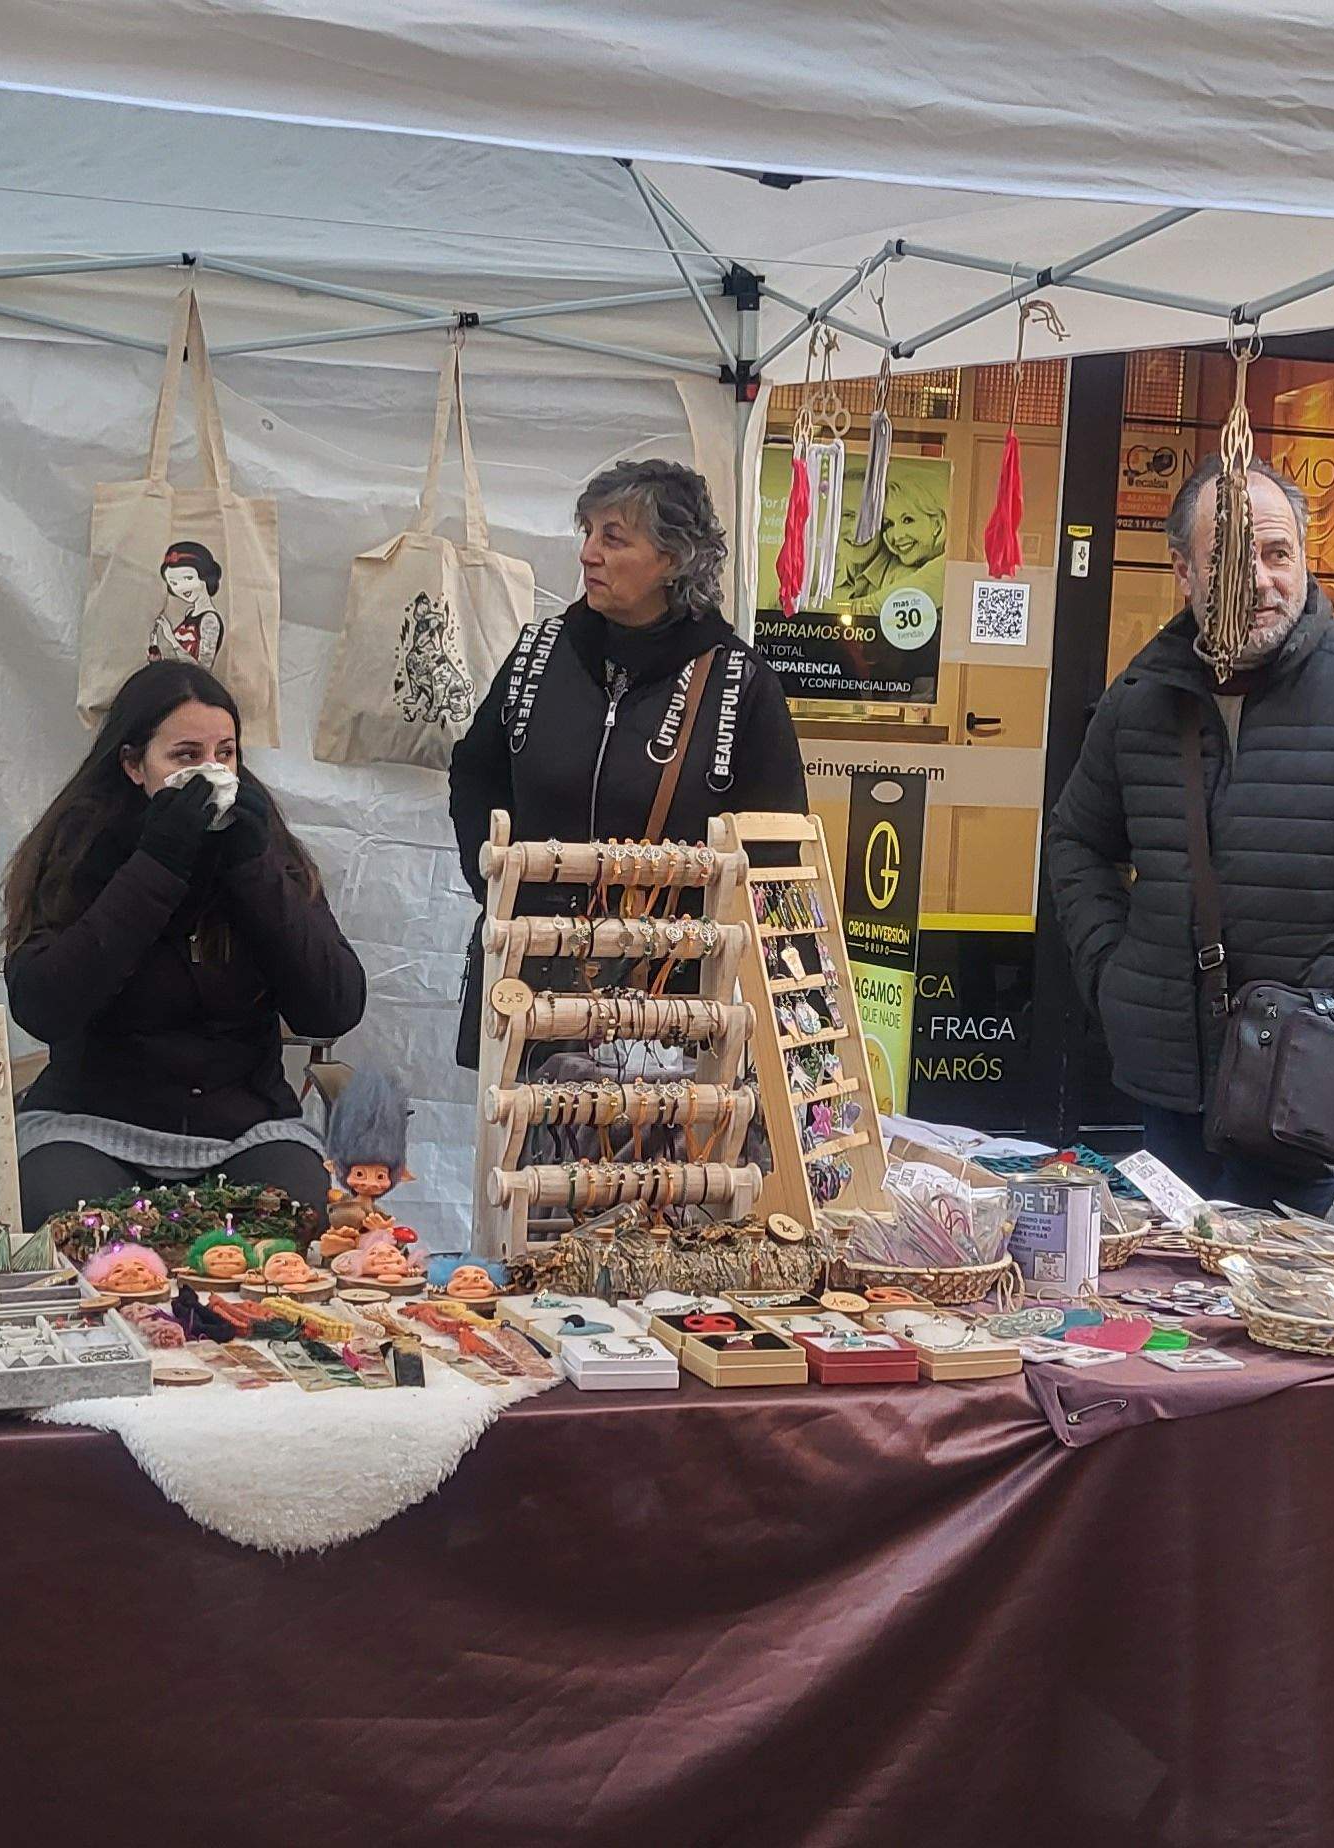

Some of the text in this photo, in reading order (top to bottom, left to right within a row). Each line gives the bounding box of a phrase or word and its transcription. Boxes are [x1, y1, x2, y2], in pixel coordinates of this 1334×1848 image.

[893, 600, 909, 608] mas
[895, 607, 922, 630] 30
[843, 627, 876, 642] ORO
[770, 644, 805, 658] TOTAL
[513, 656, 527, 672] IS
[799, 677, 912, 692] Y CONFIDENCIALIDAD
[518, 684, 538, 719] LIFE
[714, 684, 740, 776] BEAUTIFUL
[848, 920, 865, 936] ORO
[872, 923, 911, 945] INVERSIÓN
[864, 941, 890, 956] GRUPO
[915, 975, 955, 999] CA
[862, 1009, 901, 1029] QUE NADIE
[930, 1016, 1016, 1040] FRAGA
